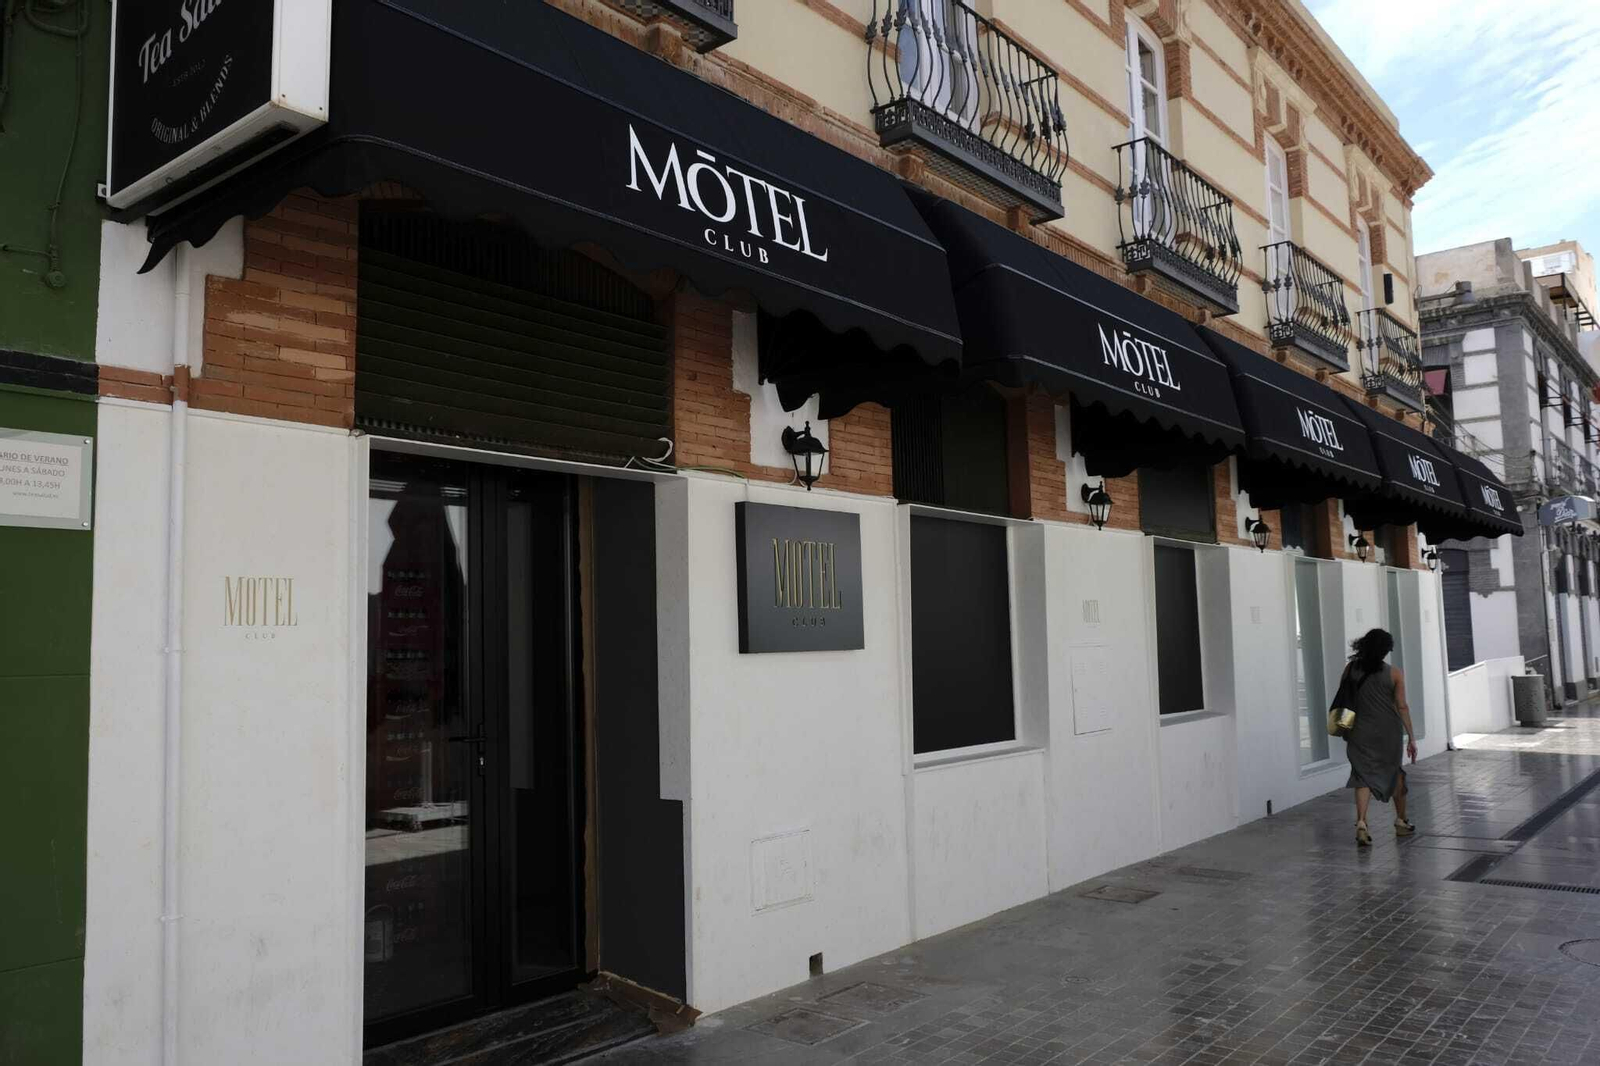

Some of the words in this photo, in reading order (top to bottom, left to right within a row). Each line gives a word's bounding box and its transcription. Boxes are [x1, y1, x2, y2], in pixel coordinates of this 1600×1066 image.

[139, 28, 172, 84] Tea
[151, 117, 190, 144] ORIGINAL
[191, 116, 199, 133] &
[200, 54, 233, 122] BLENDS
[704, 228, 769, 264] CLUB
[1134, 381, 1161, 398] CLUB
[20, 453, 31, 462] DE
[33, 455, 69, 465] VERANO
[771, 538, 842, 609] MOTEL
[223, 575, 298, 626] MOTEL
[791, 616, 826, 628] CLUB
